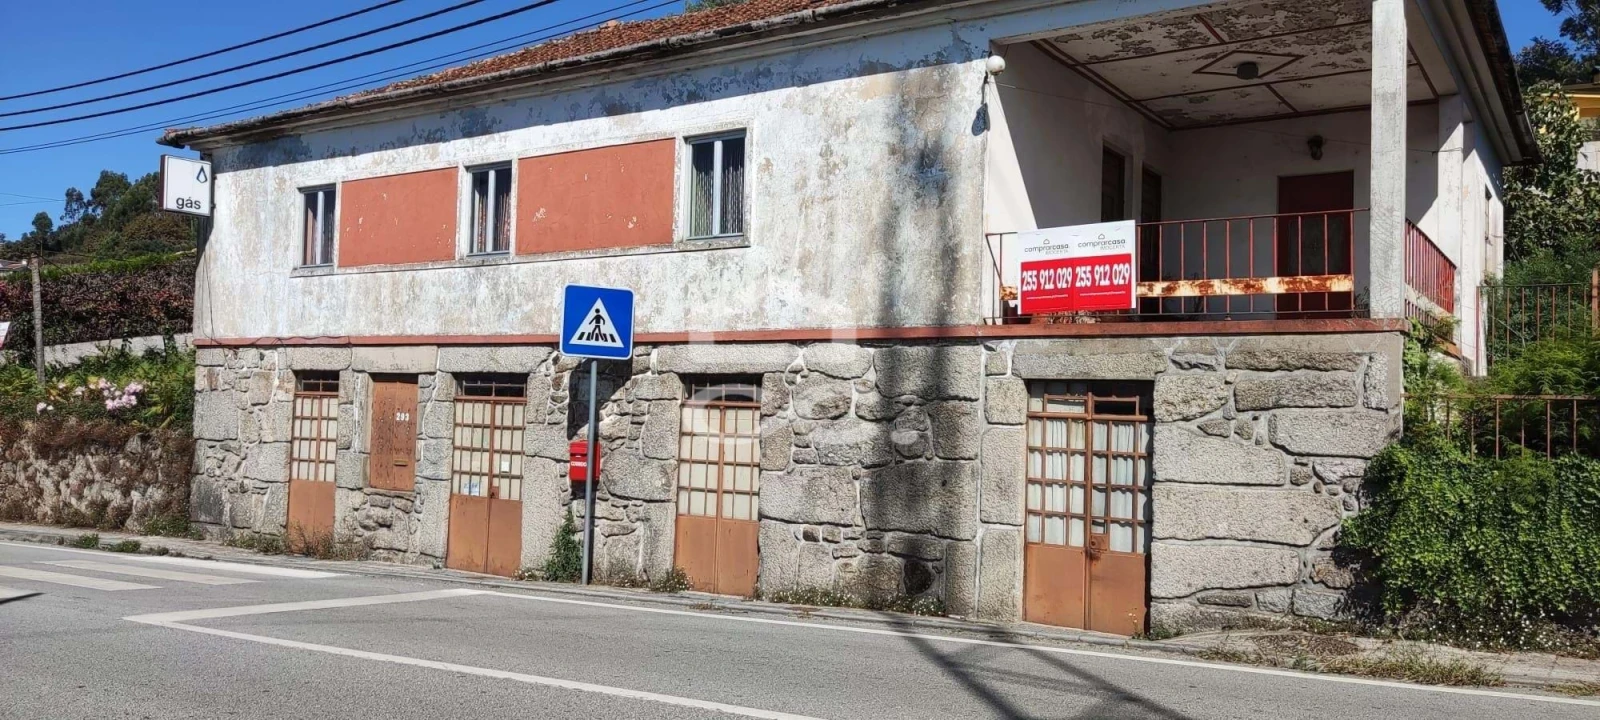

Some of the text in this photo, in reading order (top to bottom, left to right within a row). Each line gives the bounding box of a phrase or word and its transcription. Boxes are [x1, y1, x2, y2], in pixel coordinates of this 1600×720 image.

[176, 196, 201, 209] gás
[1024, 243, 1069, 253] comprarcasa
[1078, 238, 1126, 249] comprarcasa
[1022, 266, 1073, 291] 255 912 029
[1075, 262, 1130, 287] 255 912 029
[396, 412, 409, 422] 293
